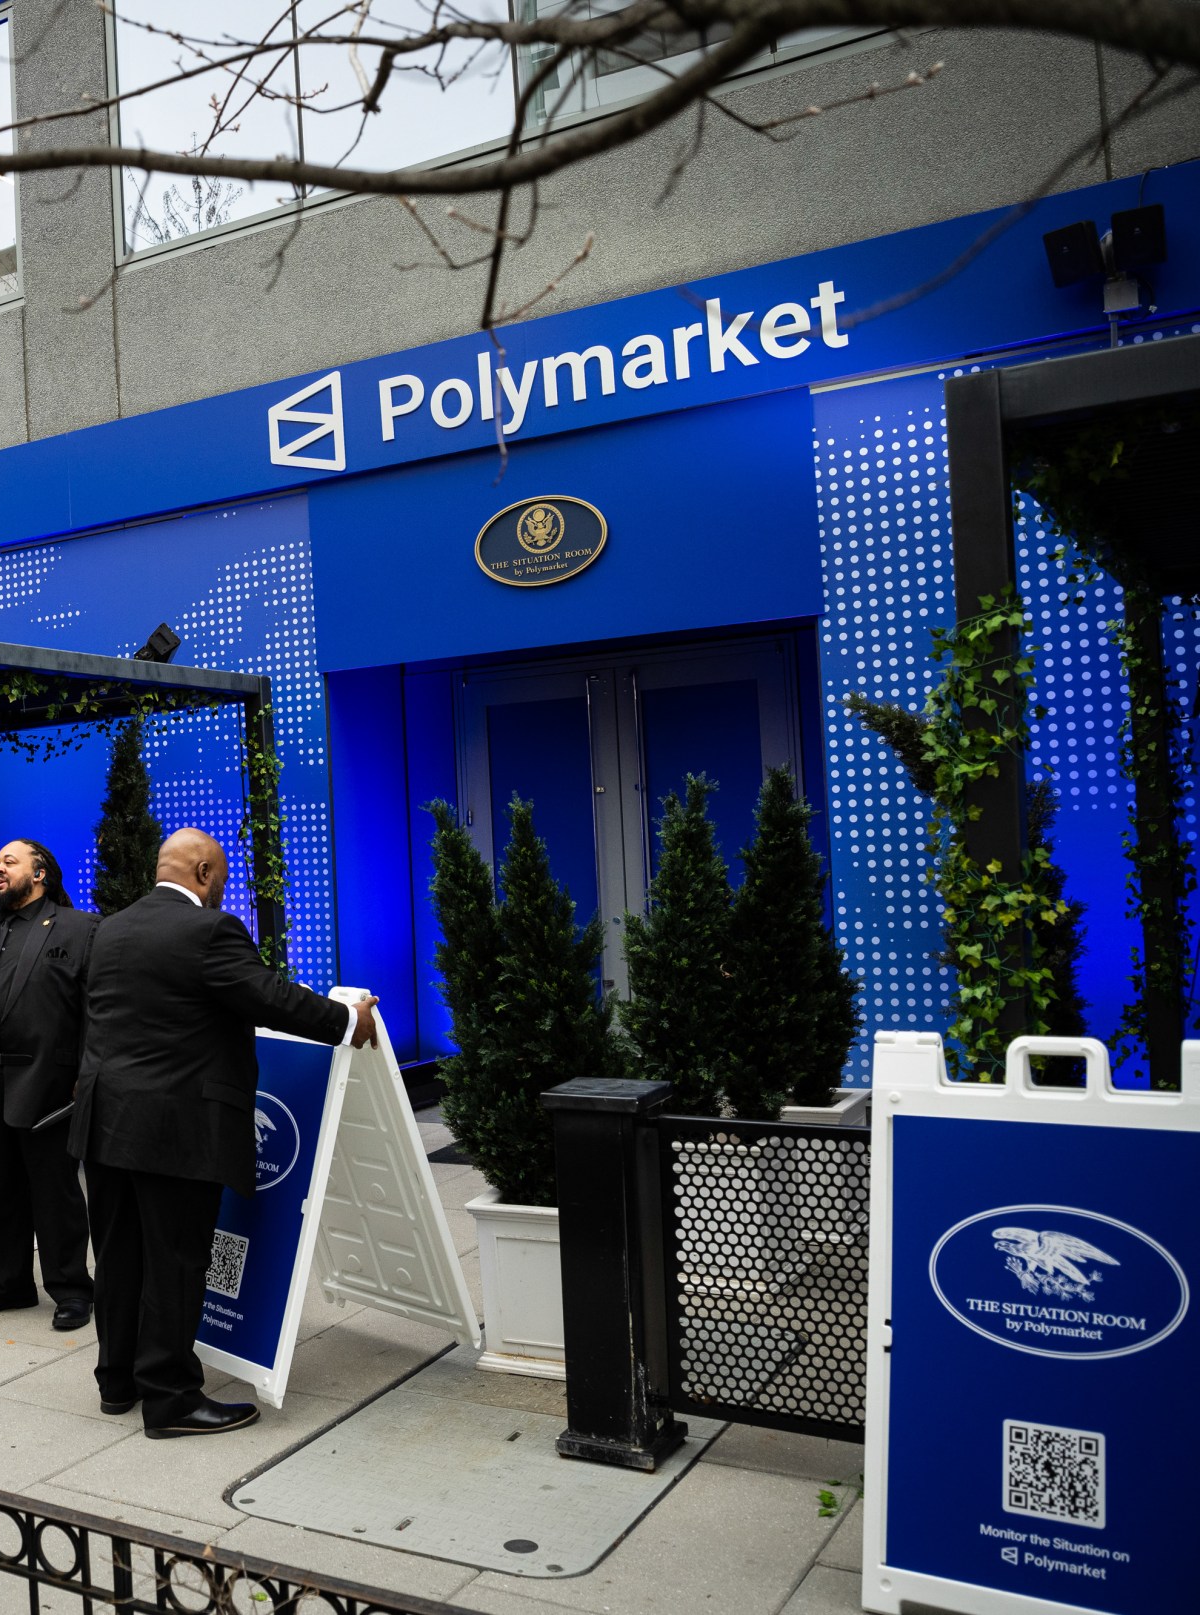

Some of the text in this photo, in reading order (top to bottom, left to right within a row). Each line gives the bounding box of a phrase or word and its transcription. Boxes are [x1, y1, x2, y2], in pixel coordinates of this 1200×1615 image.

[378, 280, 849, 442] Polymarket
[490, 548, 593, 570] THE SITUATION ROOM
[514, 562, 568, 577] by Polymarket
[258, 1160, 280, 1173] ROOM
[207, 1302, 216, 1310] the
[215, 1304, 237, 1318] Situation
[966, 1298, 1146, 1331] THE SITUATION ROOM
[202, 1313, 233, 1331] Polymarket
[1005, 1318, 1103, 1341] by Polymarket
[979, 1523, 1130, 1563] Monitor the Situation on
[1024, 1552, 1107, 1580] Polymarket
